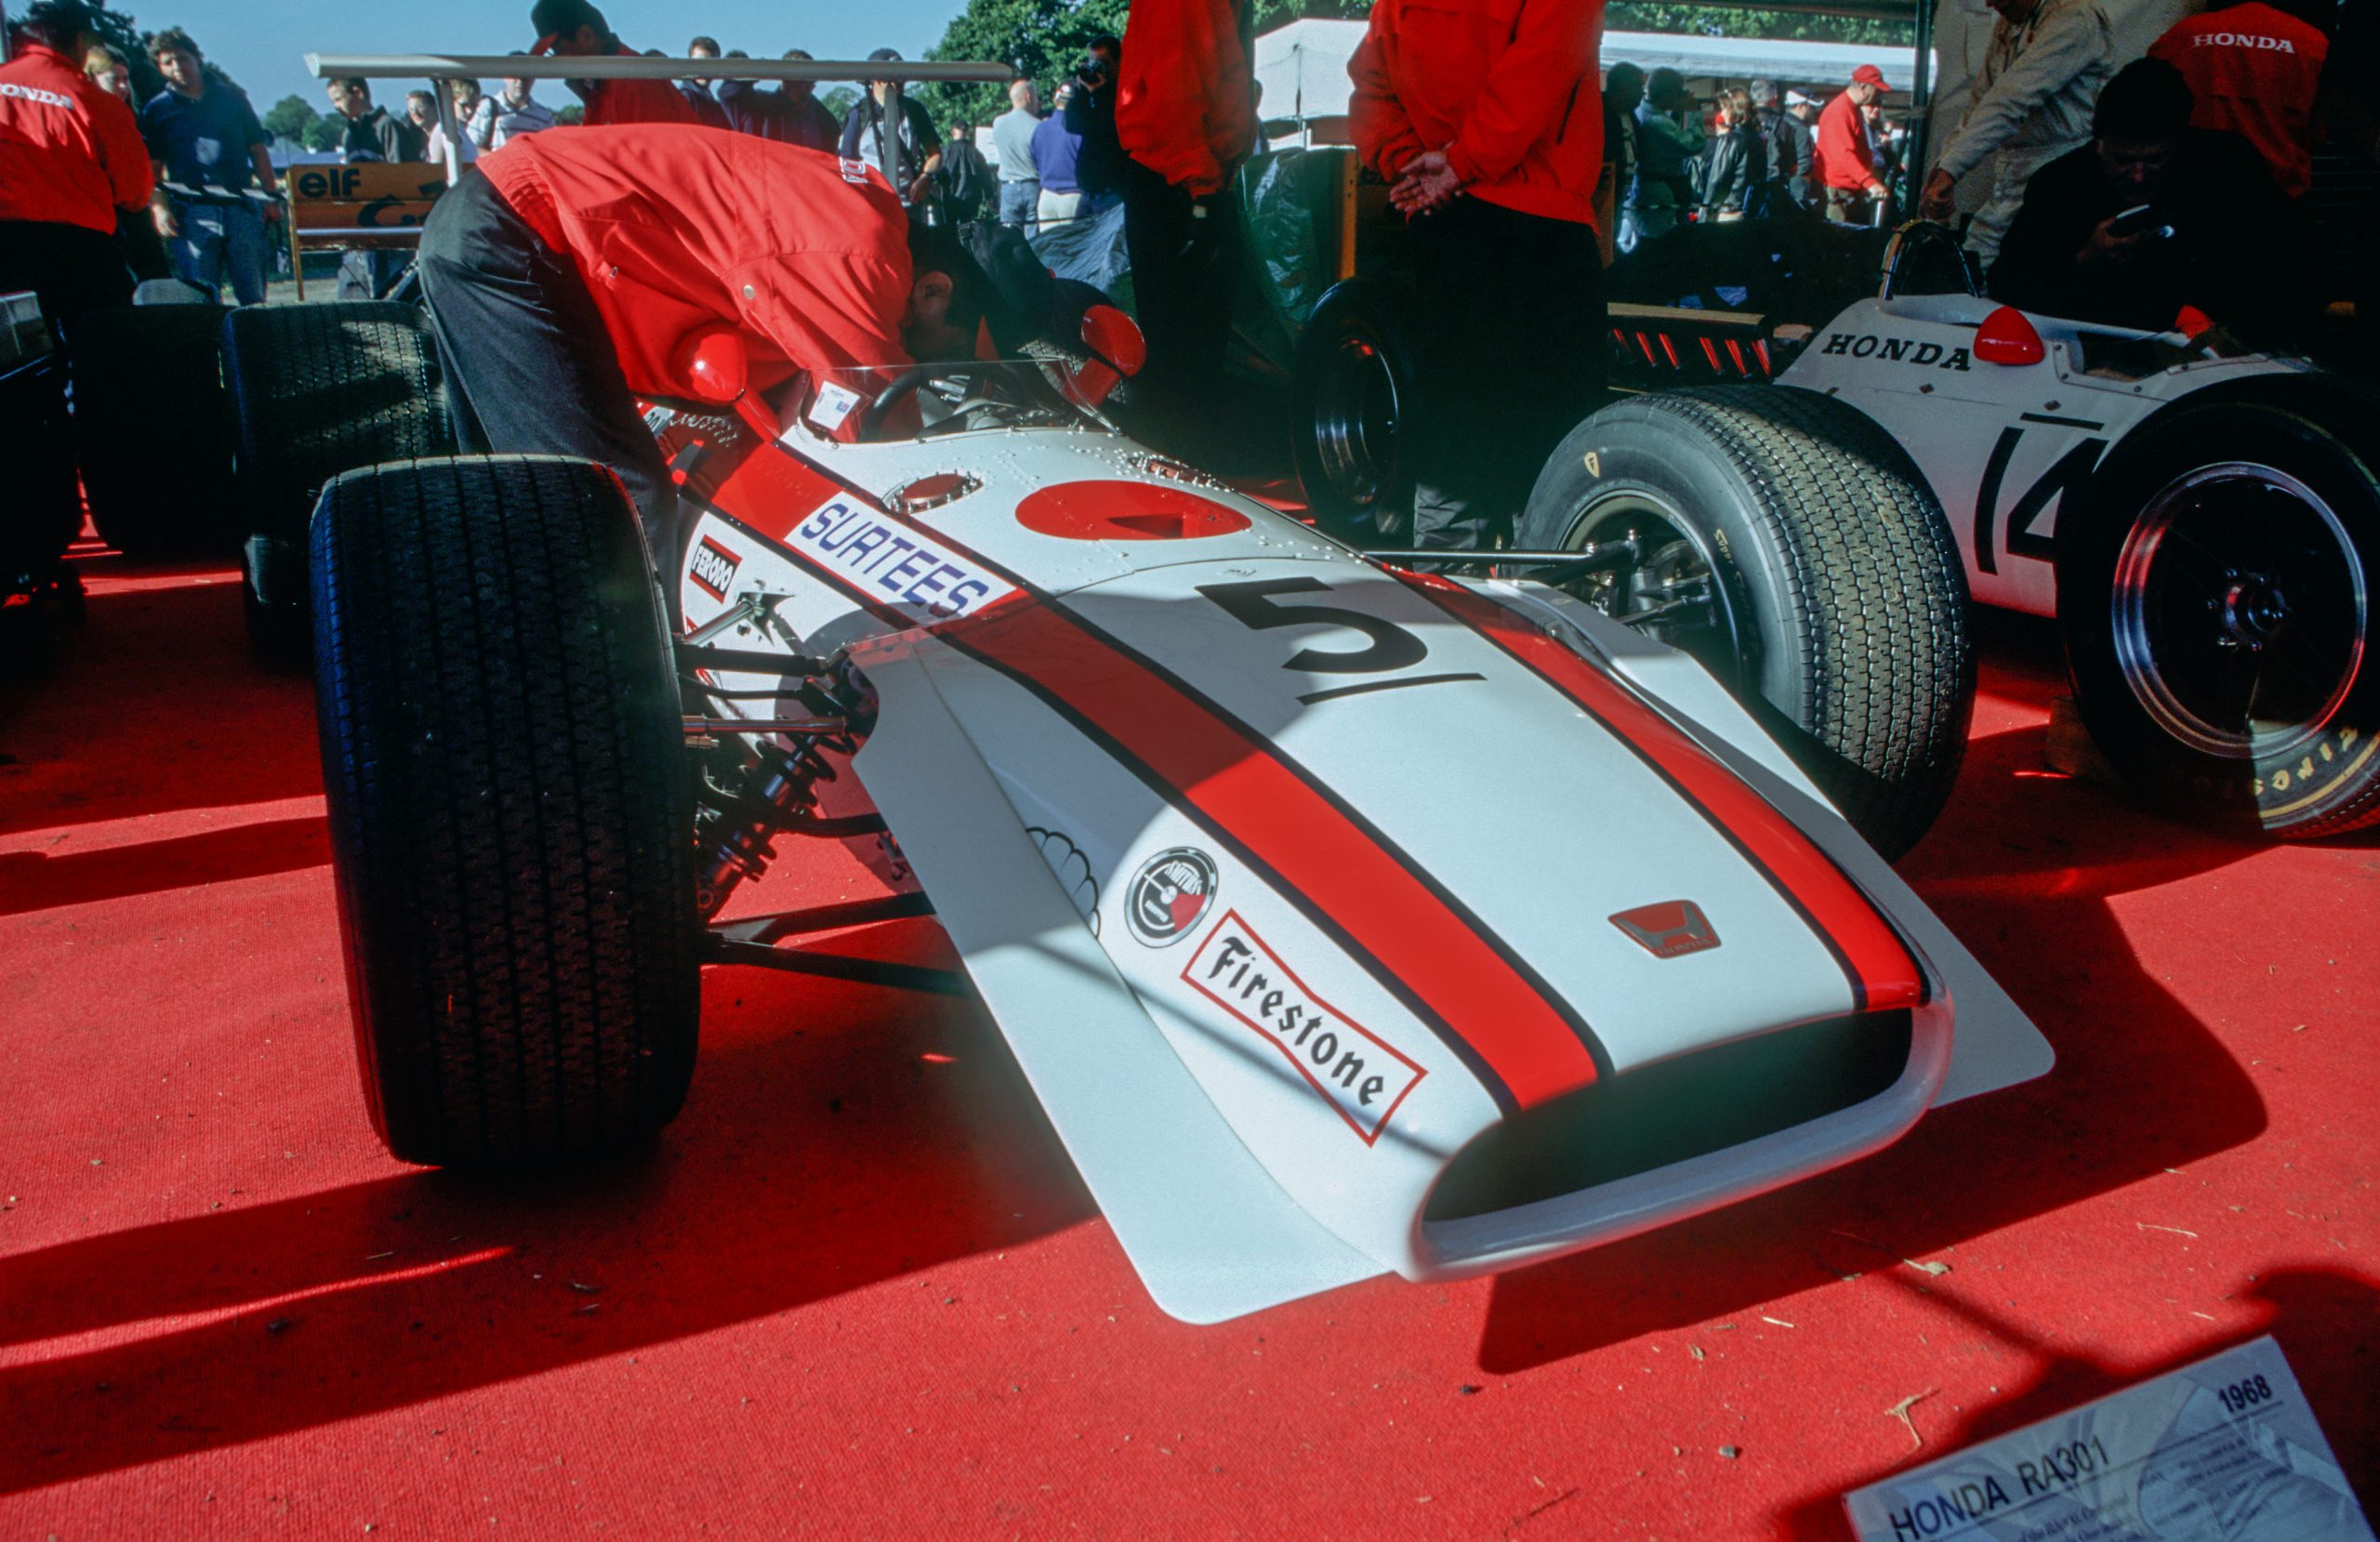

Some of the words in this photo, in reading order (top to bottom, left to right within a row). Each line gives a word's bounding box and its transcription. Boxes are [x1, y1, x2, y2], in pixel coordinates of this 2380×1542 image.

[2193, 33, 2294, 54] HONDA
[0, 83, 74, 110] ONDA
[298, 168, 361, 199] elf
[1820, 334, 1972, 373] HONDA
[691, 544, 734, 593] FERODO
[800, 502, 990, 619] SURTEES
[1194, 575, 1429, 674] 5
[1208, 936, 1384, 1106] Firestone
[2218, 1375, 2272, 1413] 1968
[1888, 1474, 2010, 1542] HONDA
[2016, 1435, 2109, 1496] RA301
